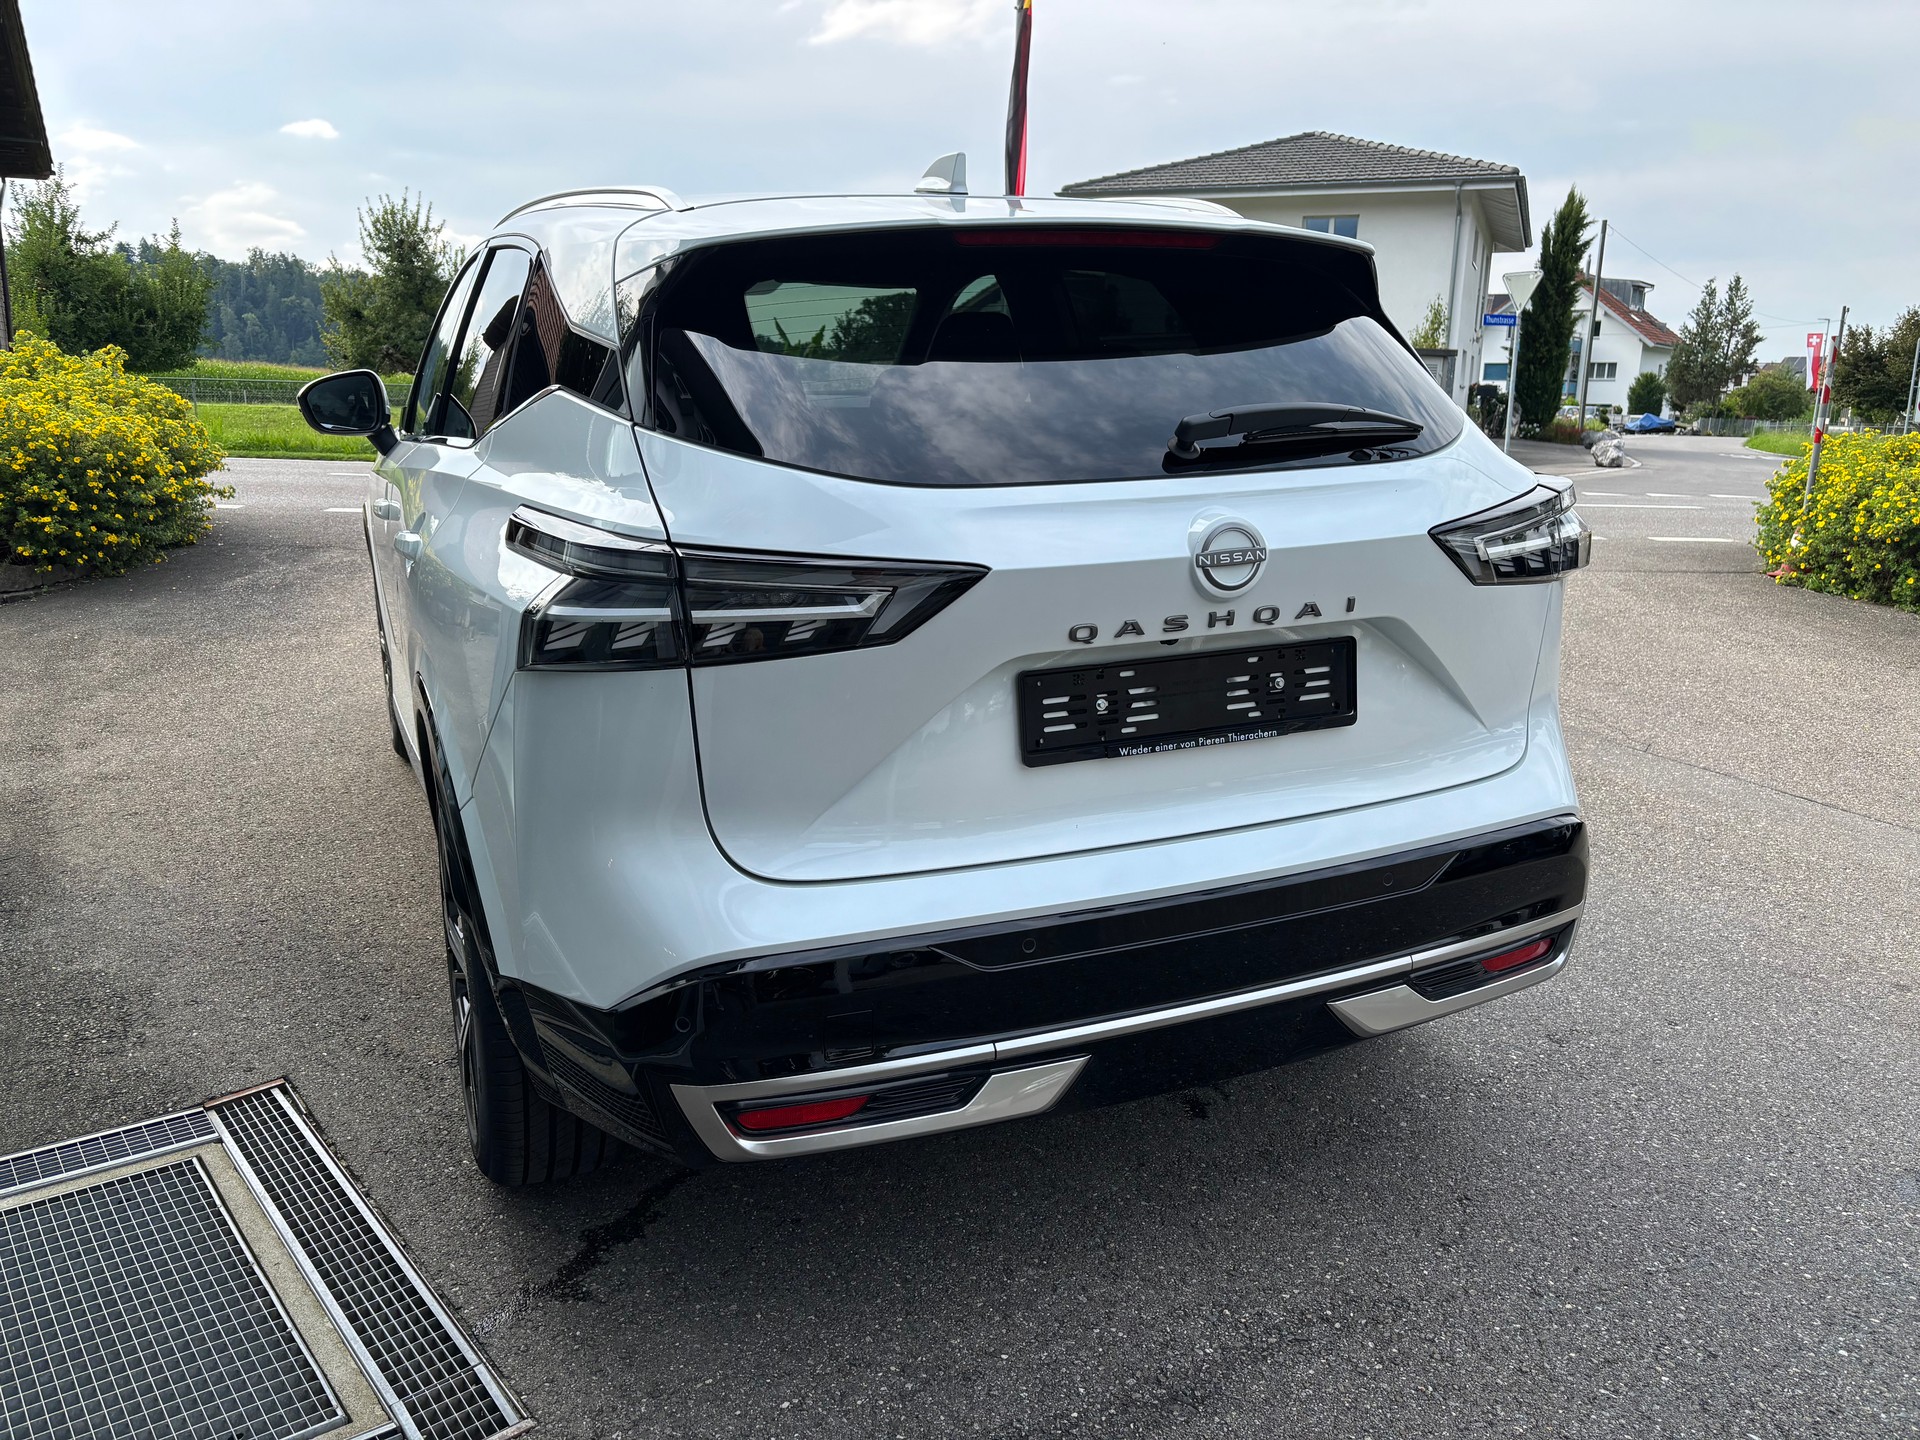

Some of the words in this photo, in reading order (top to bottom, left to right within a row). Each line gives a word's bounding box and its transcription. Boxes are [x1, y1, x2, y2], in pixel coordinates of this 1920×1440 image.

[1486, 315, 1515, 324] Thunstrasse
[1198, 550, 1266, 566] NISSAN
[1068, 596, 1356, 644] QASHQAI
[1119, 745, 1152, 756] Wieder
[1155, 743, 1177, 751] einer
[1199, 737, 1226, 746] Pieren
[1228, 729, 1278, 742] Thierachern
